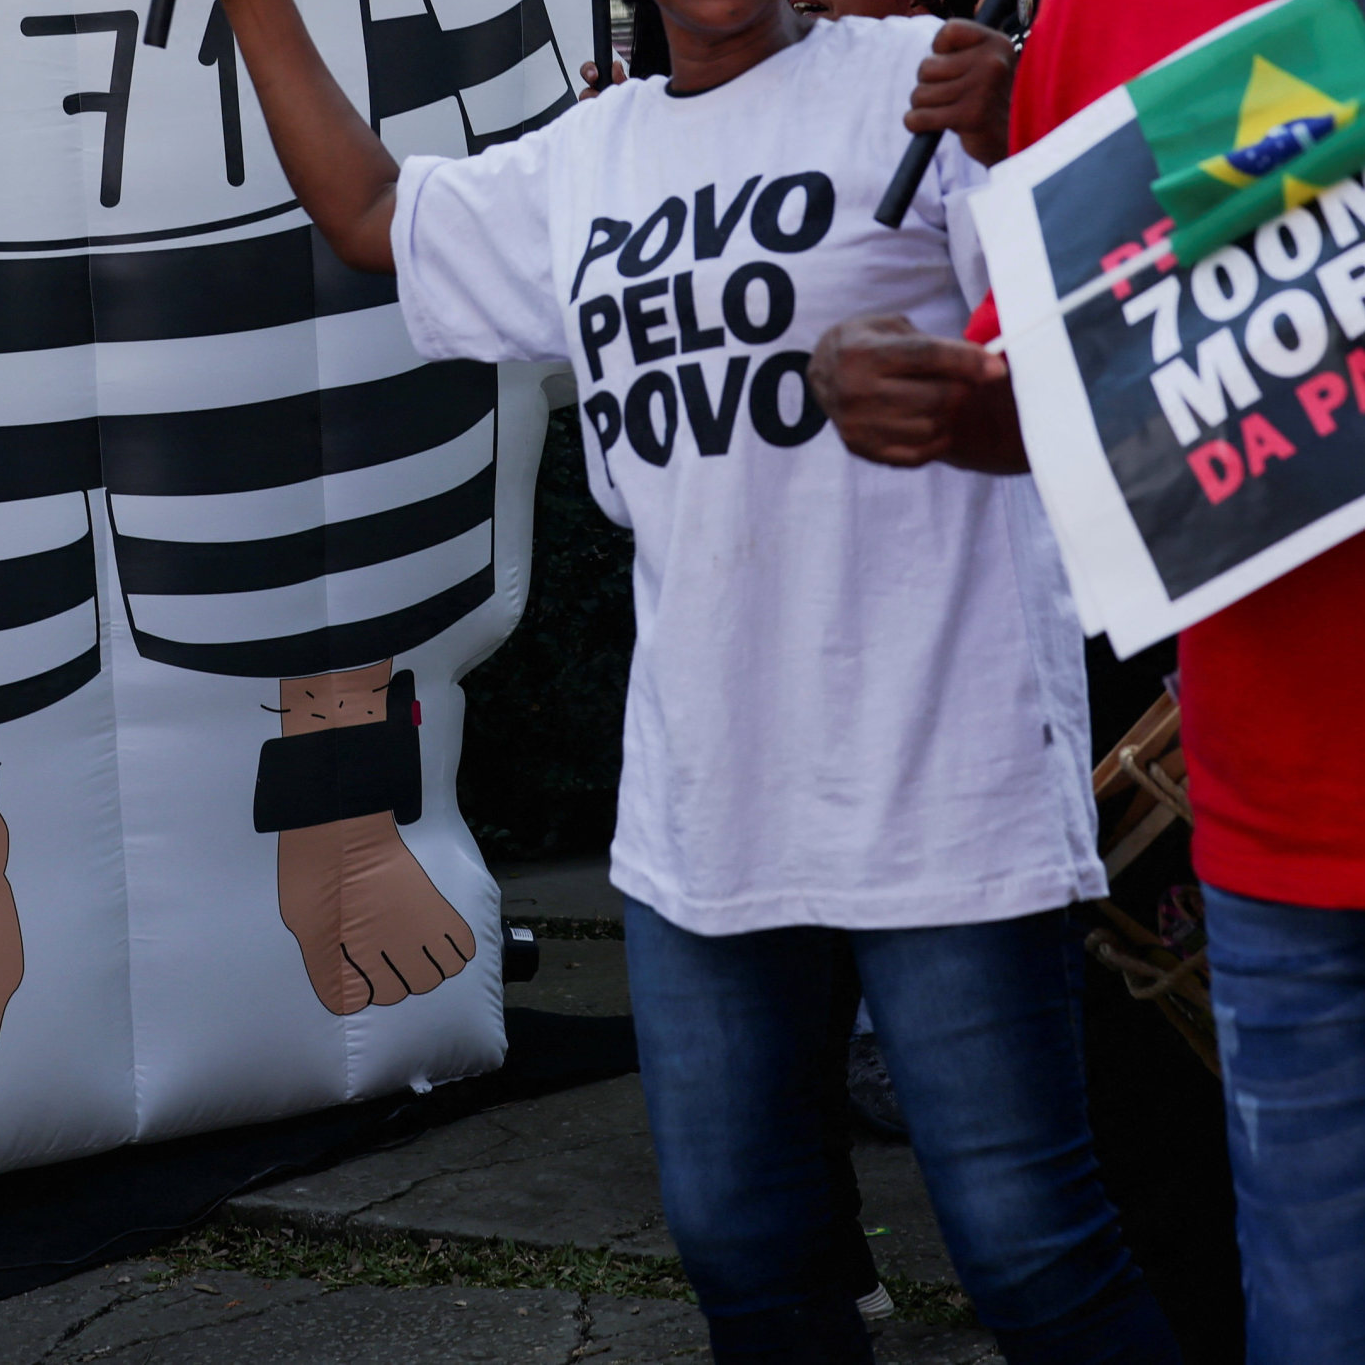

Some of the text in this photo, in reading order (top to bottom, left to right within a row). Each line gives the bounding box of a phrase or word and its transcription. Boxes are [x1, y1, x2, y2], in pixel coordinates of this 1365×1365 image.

[570, 170, 835, 305] POVO
[579, 261, 795, 382] PELO
[584, 350, 830, 488] POVO
[1186, 413, 1296, 507] DA
